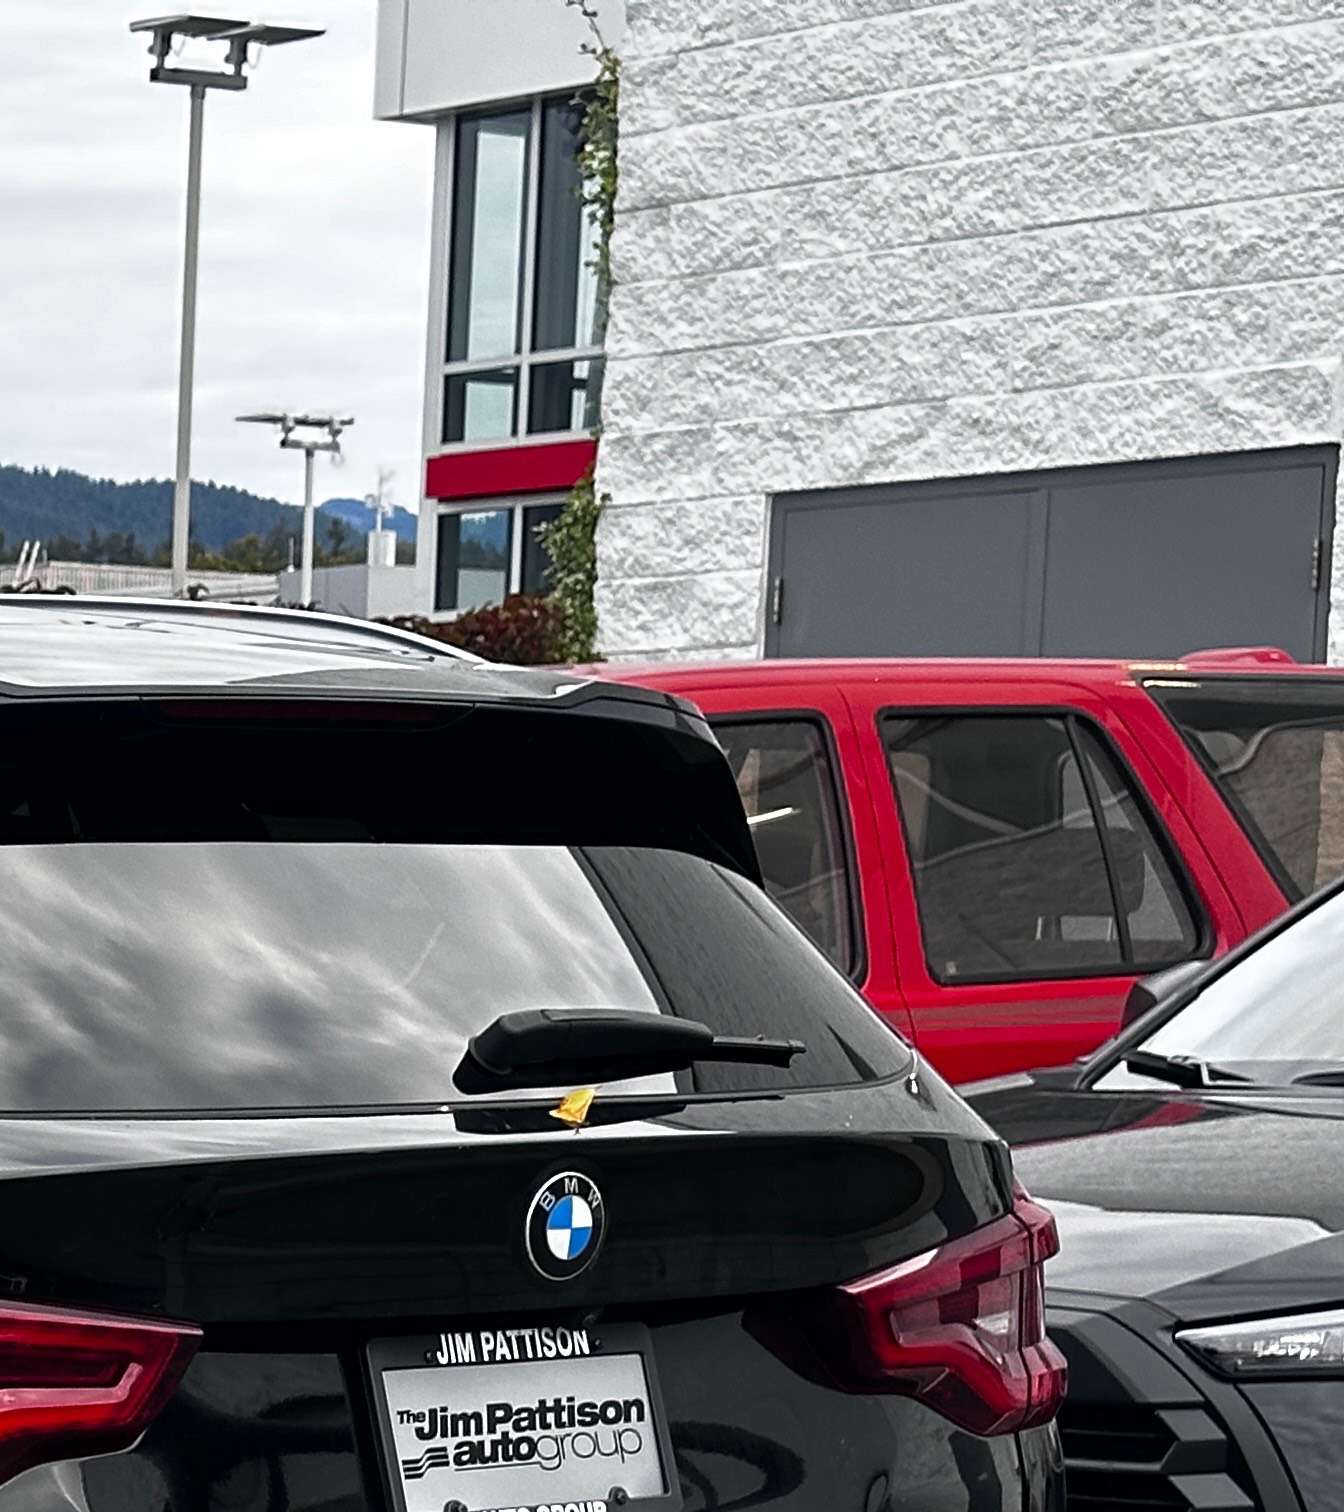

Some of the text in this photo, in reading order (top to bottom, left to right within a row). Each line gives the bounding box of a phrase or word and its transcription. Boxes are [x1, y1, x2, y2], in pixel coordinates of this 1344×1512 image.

[539, 1177, 600, 1212] BMW
[436, 1327, 590, 1364] JIM PATTISON
[397, 1409, 426, 1425] The
